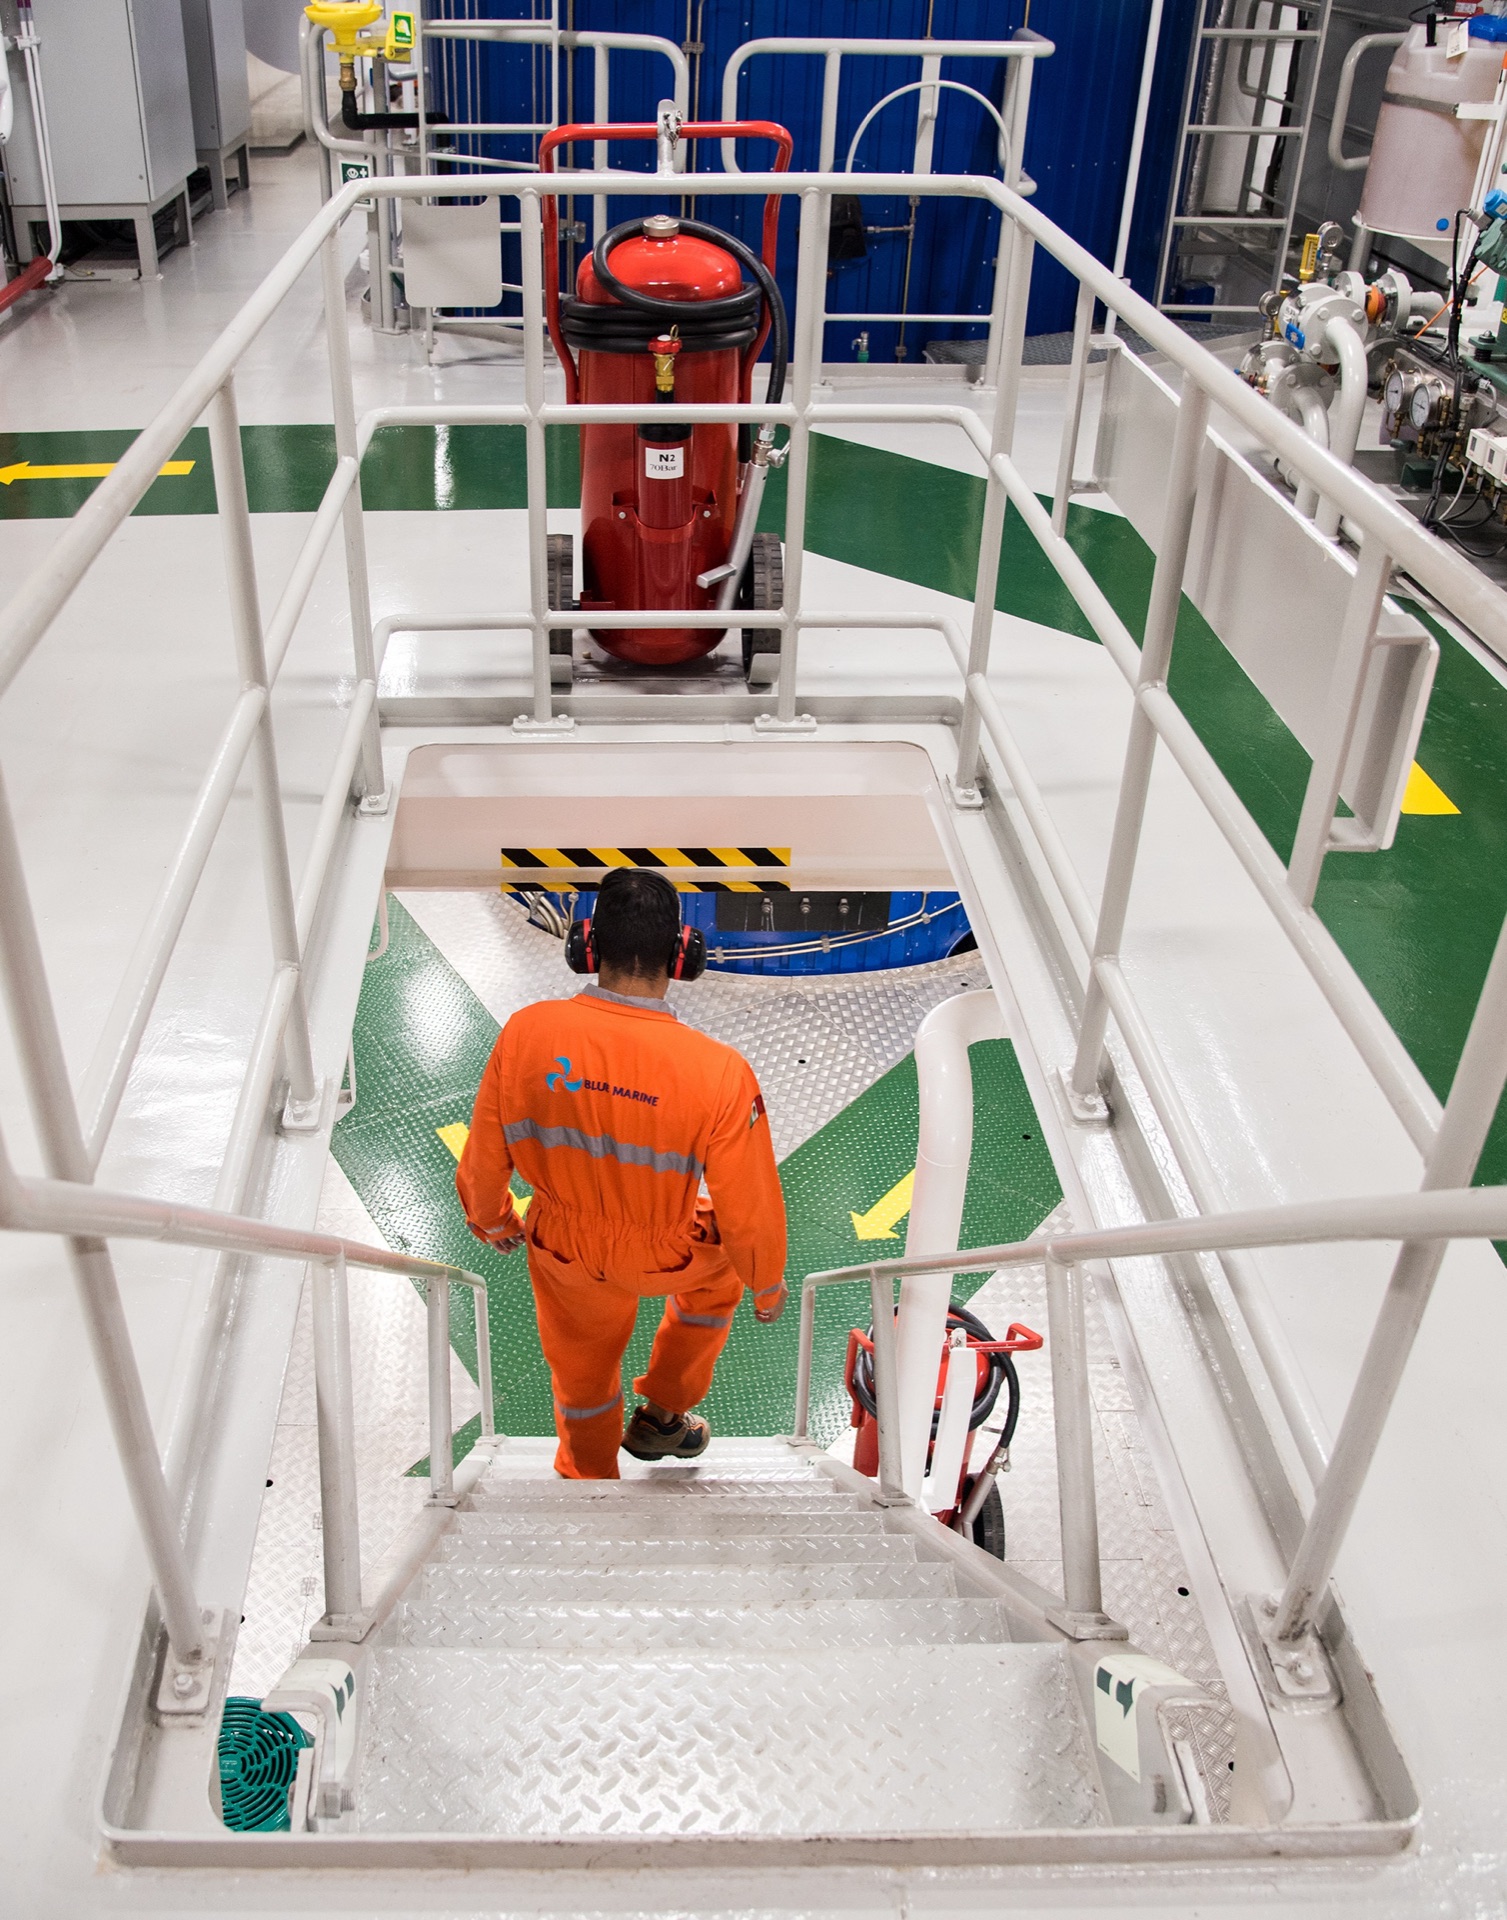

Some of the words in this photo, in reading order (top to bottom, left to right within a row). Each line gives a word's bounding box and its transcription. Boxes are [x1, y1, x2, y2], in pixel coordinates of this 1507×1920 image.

[659, 454, 676, 462] N2
[584, 1079, 610, 1093] BLUE
[612, 1086, 659, 1107] MARINE
